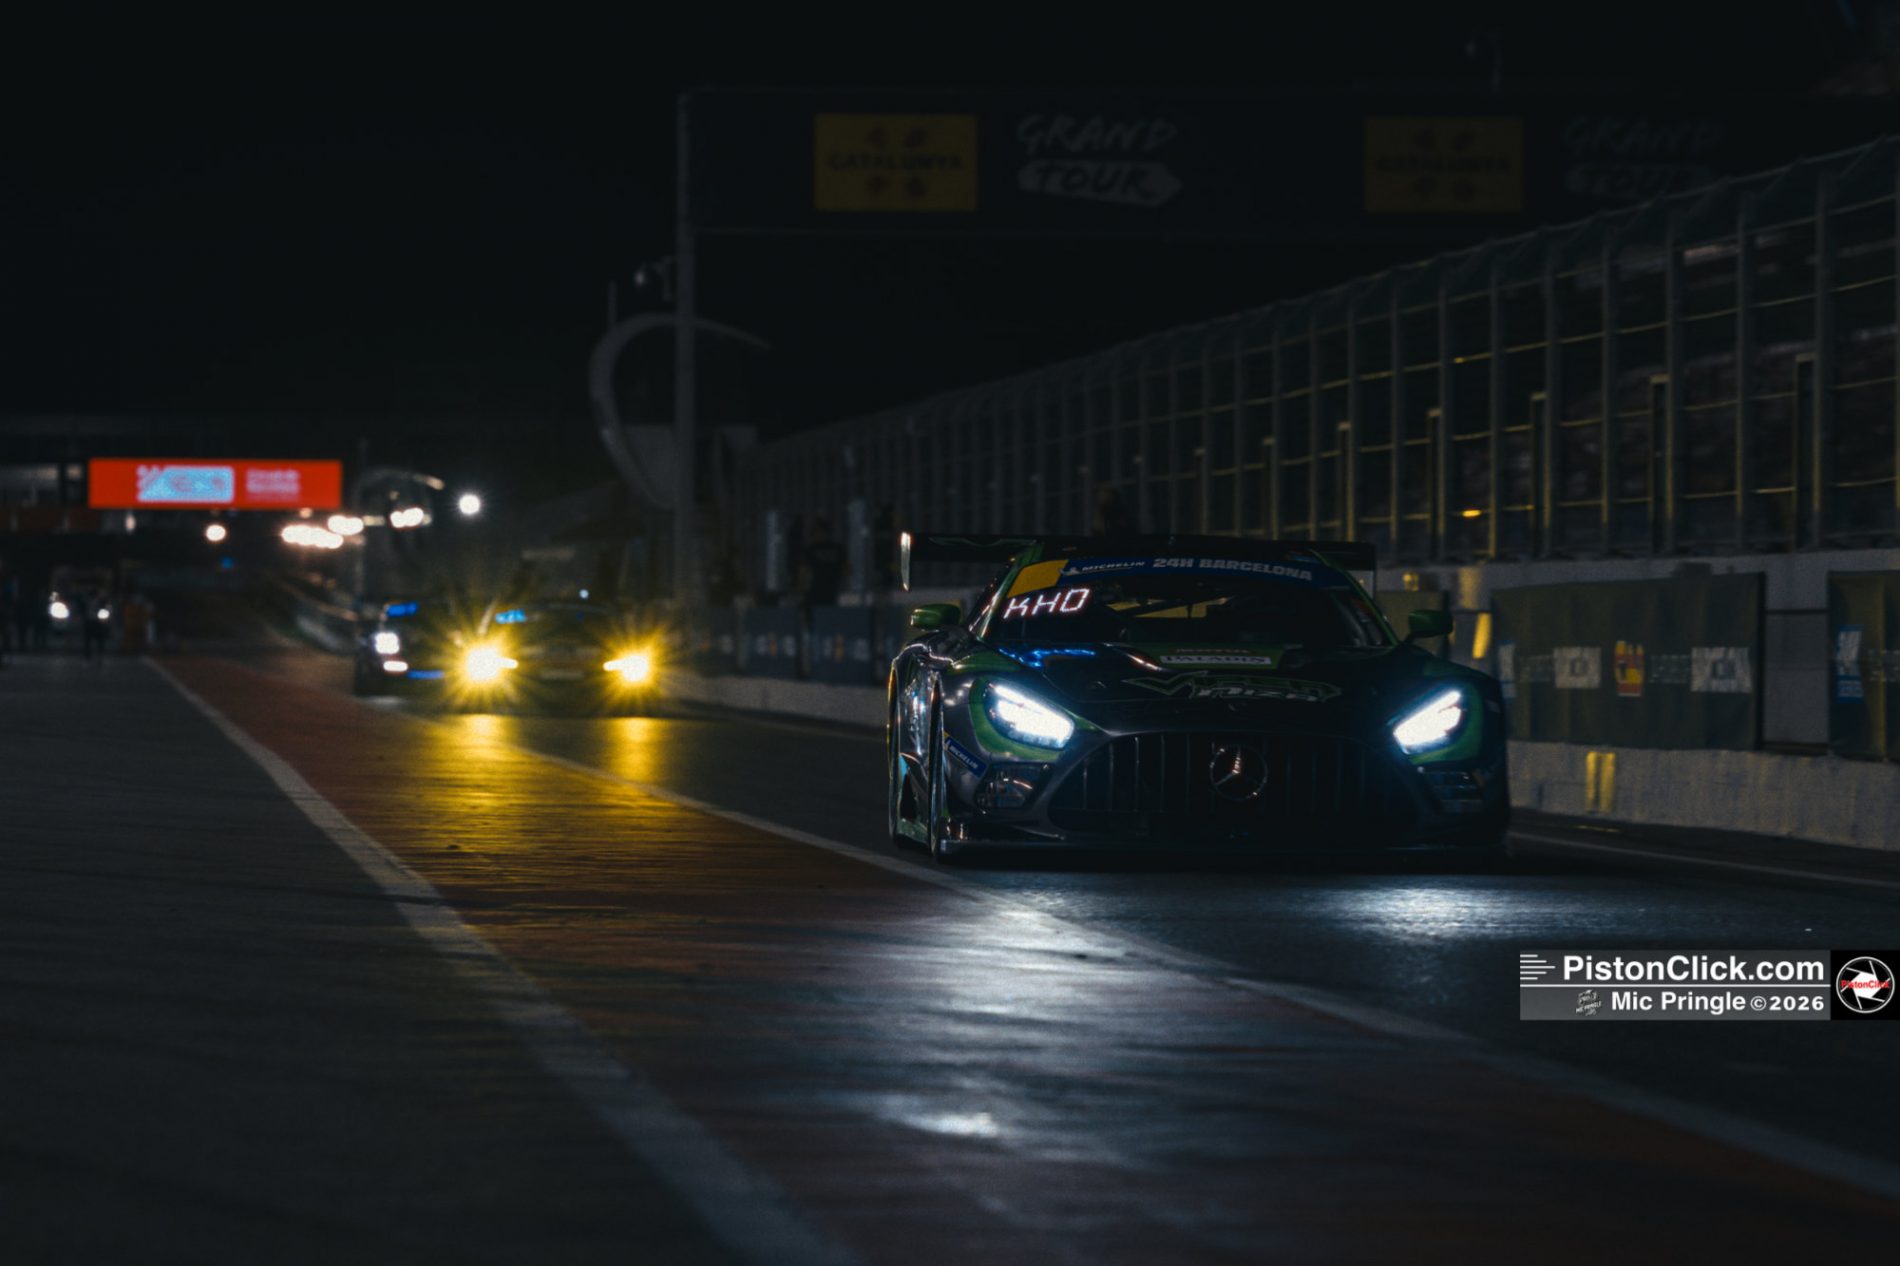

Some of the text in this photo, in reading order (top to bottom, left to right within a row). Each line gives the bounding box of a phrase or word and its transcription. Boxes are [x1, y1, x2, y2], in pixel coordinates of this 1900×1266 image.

[1018, 114, 1179, 156] GRAND
[1035, 164, 1149, 197] TOUR
[1152, 557, 1313, 581] 24H BARCELONA
